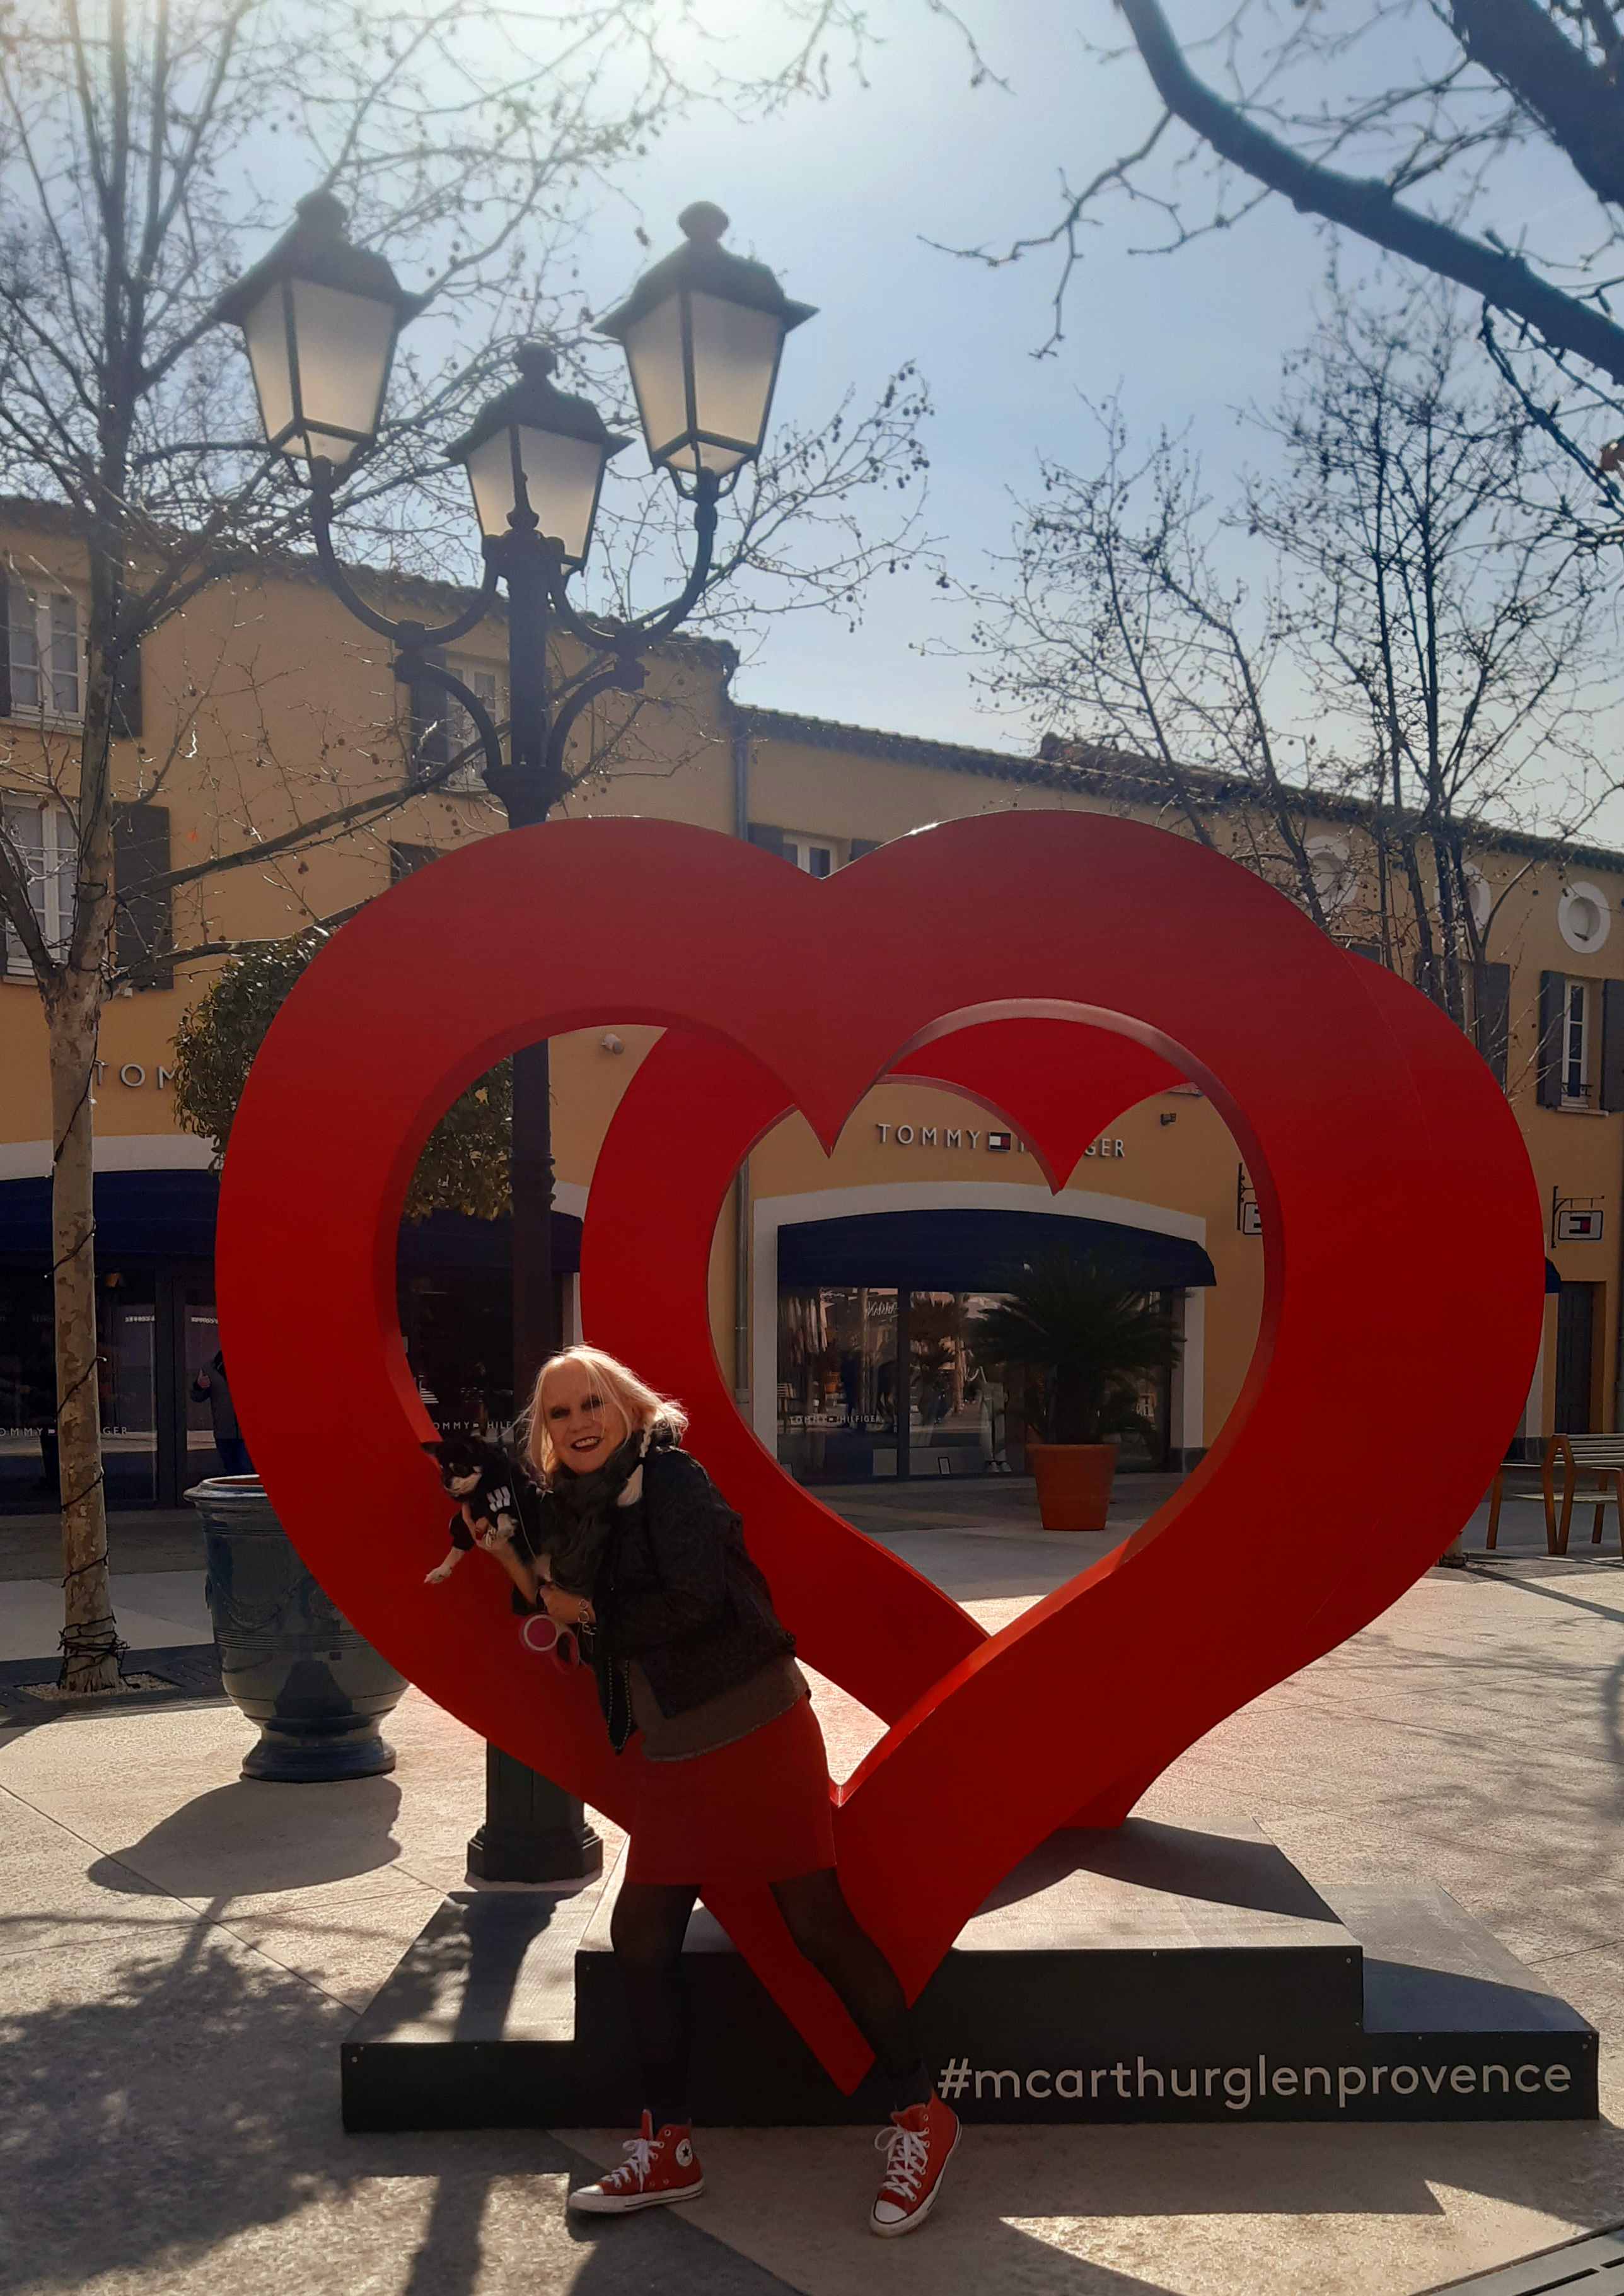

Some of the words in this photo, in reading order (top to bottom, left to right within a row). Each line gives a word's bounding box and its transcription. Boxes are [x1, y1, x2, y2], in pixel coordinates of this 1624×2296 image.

[93, 1059, 175, 1089] TOM
[878, 1123, 981, 1149] TOMMY
[0, 1427, 43, 1436] OMMY
[434, 1421, 470, 1430] OMMY
[487, 1421, 512, 1429] HILF
[937, 2054, 1572, 2110] #mcarthurglenprovence
